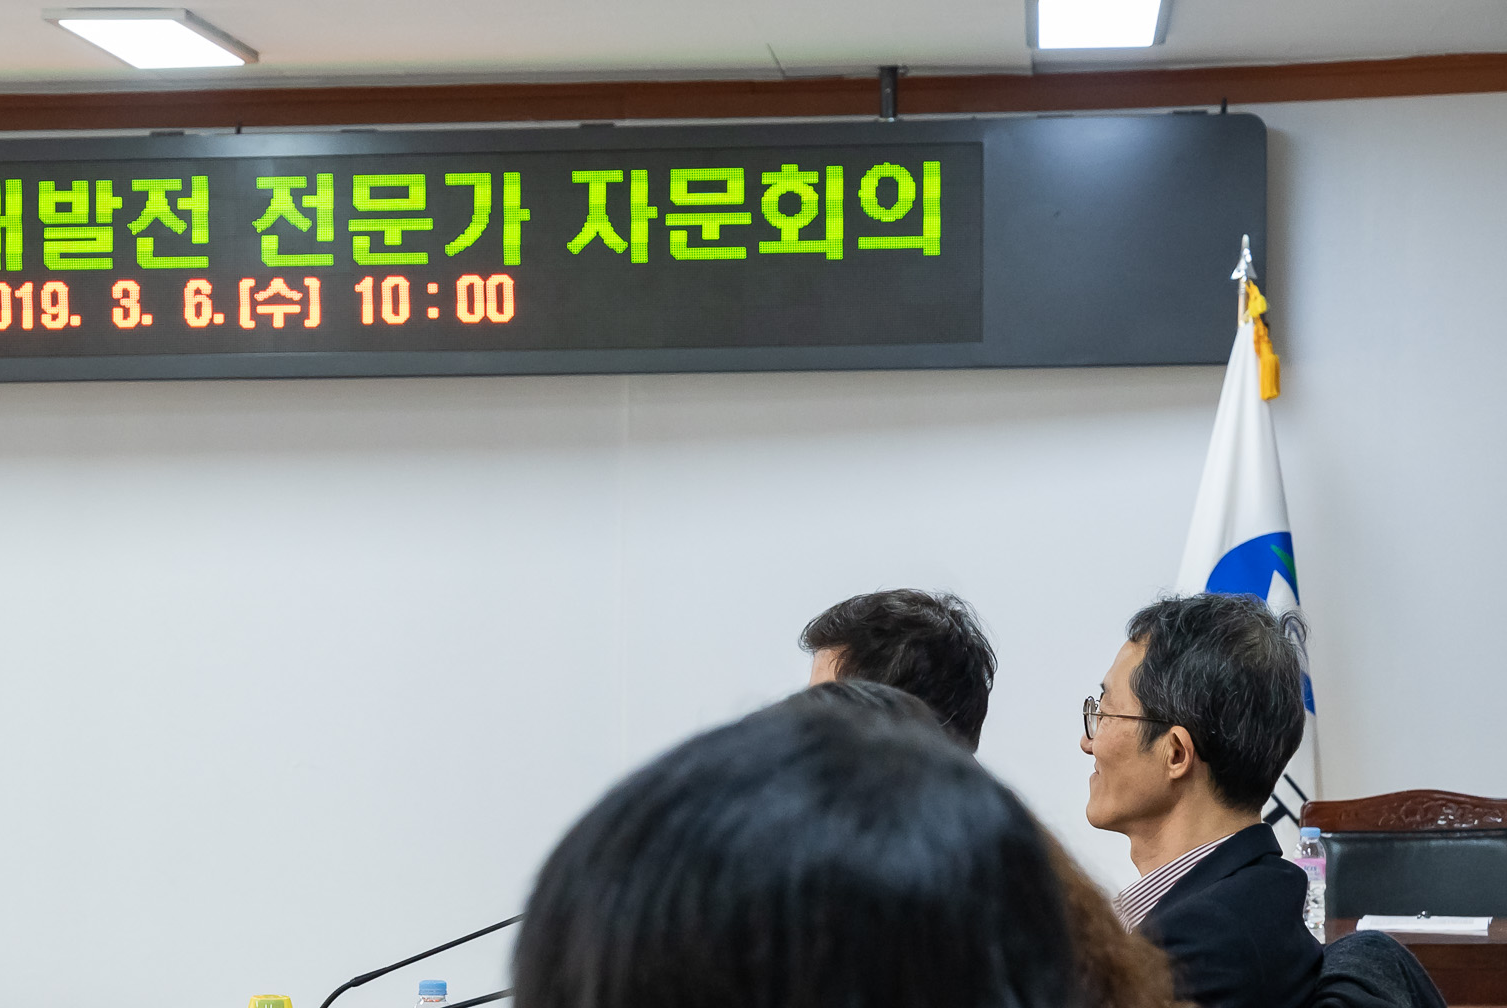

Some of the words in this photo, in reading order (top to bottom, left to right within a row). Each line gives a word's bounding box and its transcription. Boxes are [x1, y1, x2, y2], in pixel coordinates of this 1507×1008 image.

[251, 171, 531, 268] 전문가
[566, 160, 942, 264] 자문회의
[111, 278, 154, 329] 3.
